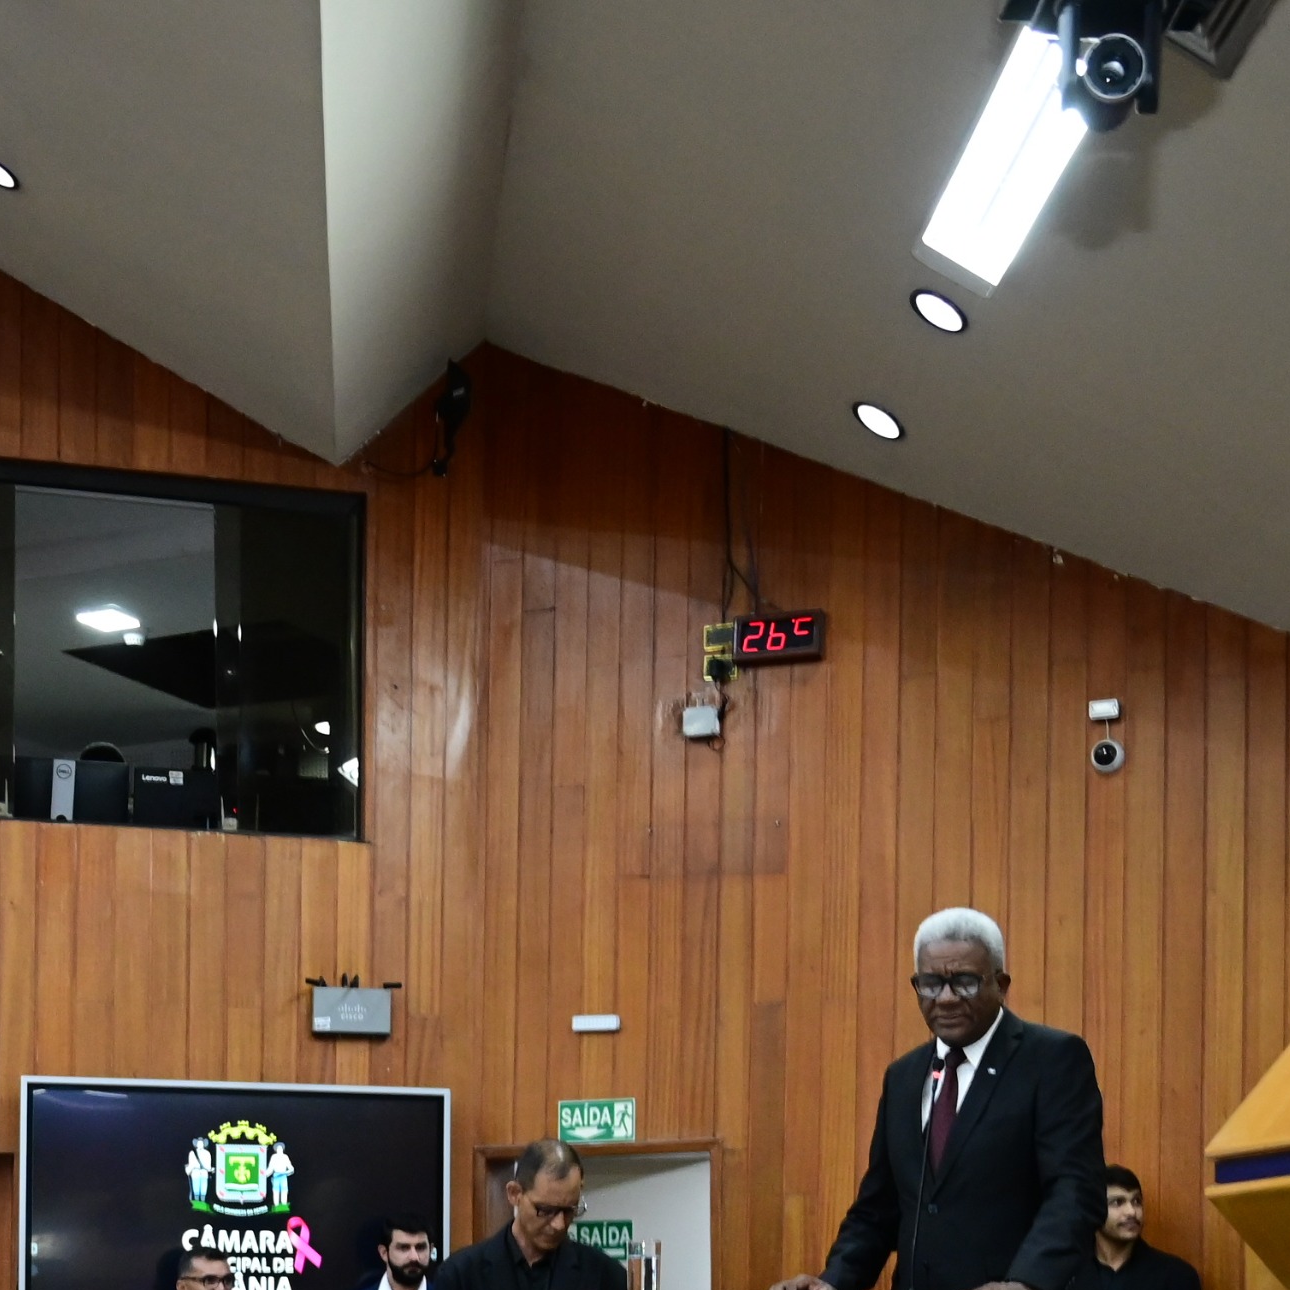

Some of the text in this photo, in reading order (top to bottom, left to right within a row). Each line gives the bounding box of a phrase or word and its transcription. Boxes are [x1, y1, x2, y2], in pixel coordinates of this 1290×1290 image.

[141, 773, 168, 782] Lenovo
[561, 1102, 612, 1128] SAÍDA
[181, 1223, 294, 1255] CÂMARA
[580, 1221, 630, 1247] SAÍDA
[226, 1256, 295, 1274] CIPAL DE
